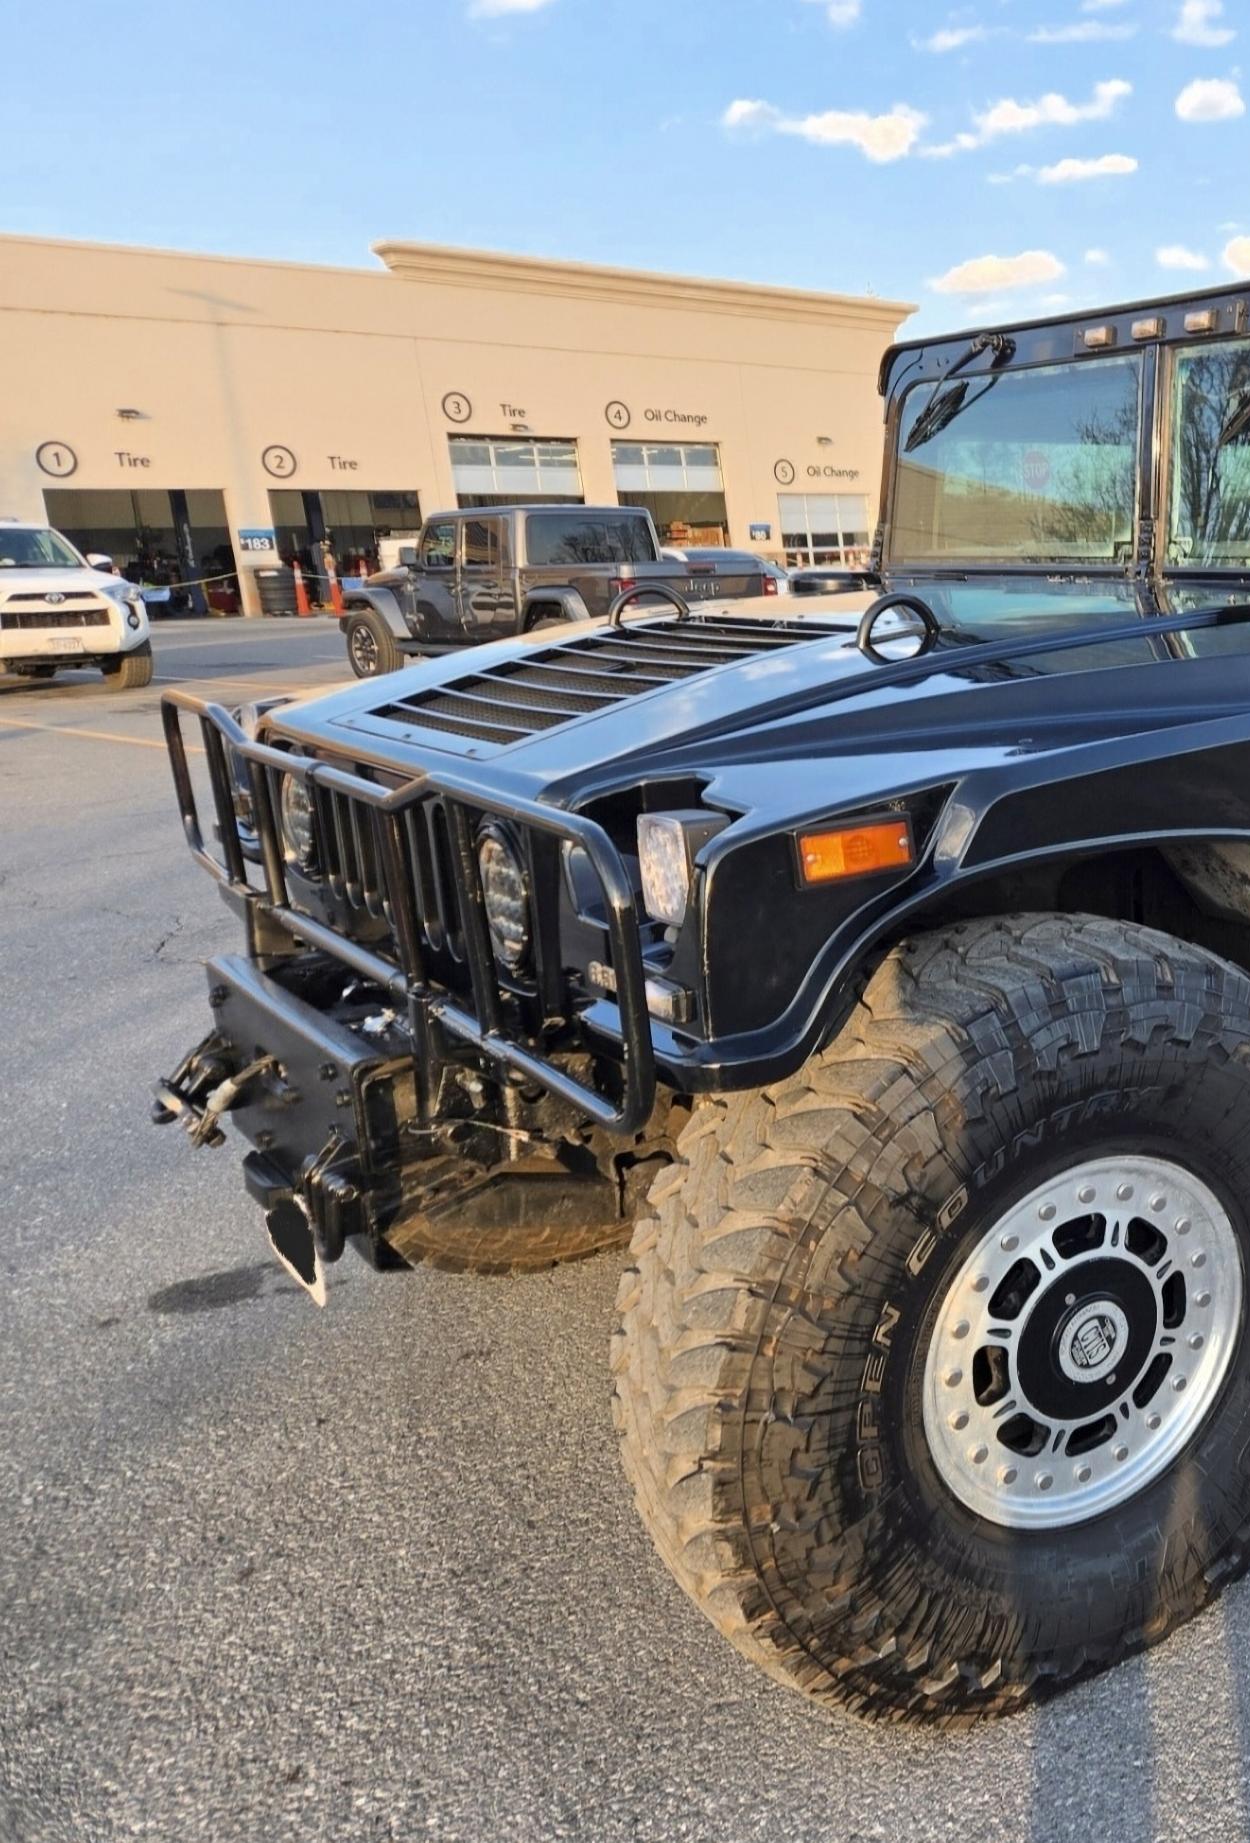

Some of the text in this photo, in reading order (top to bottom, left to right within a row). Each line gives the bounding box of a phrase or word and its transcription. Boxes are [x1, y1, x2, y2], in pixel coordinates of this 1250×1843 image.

[452, 401, 462, 415] 3
[499, 403, 526, 418] Tire
[613, 409, 623, 422] 4
[644, 408, 708, 427] Oil Change
[53, 452, 61, 468] 1
[114, 451, 151, 469] Tire
[274, 454, 286, 469] 2
[327, 455, 359, 471] Tire
[806, 465, 860, 482] Oil Change
[856, 1301, 901, 1490] OPEN
